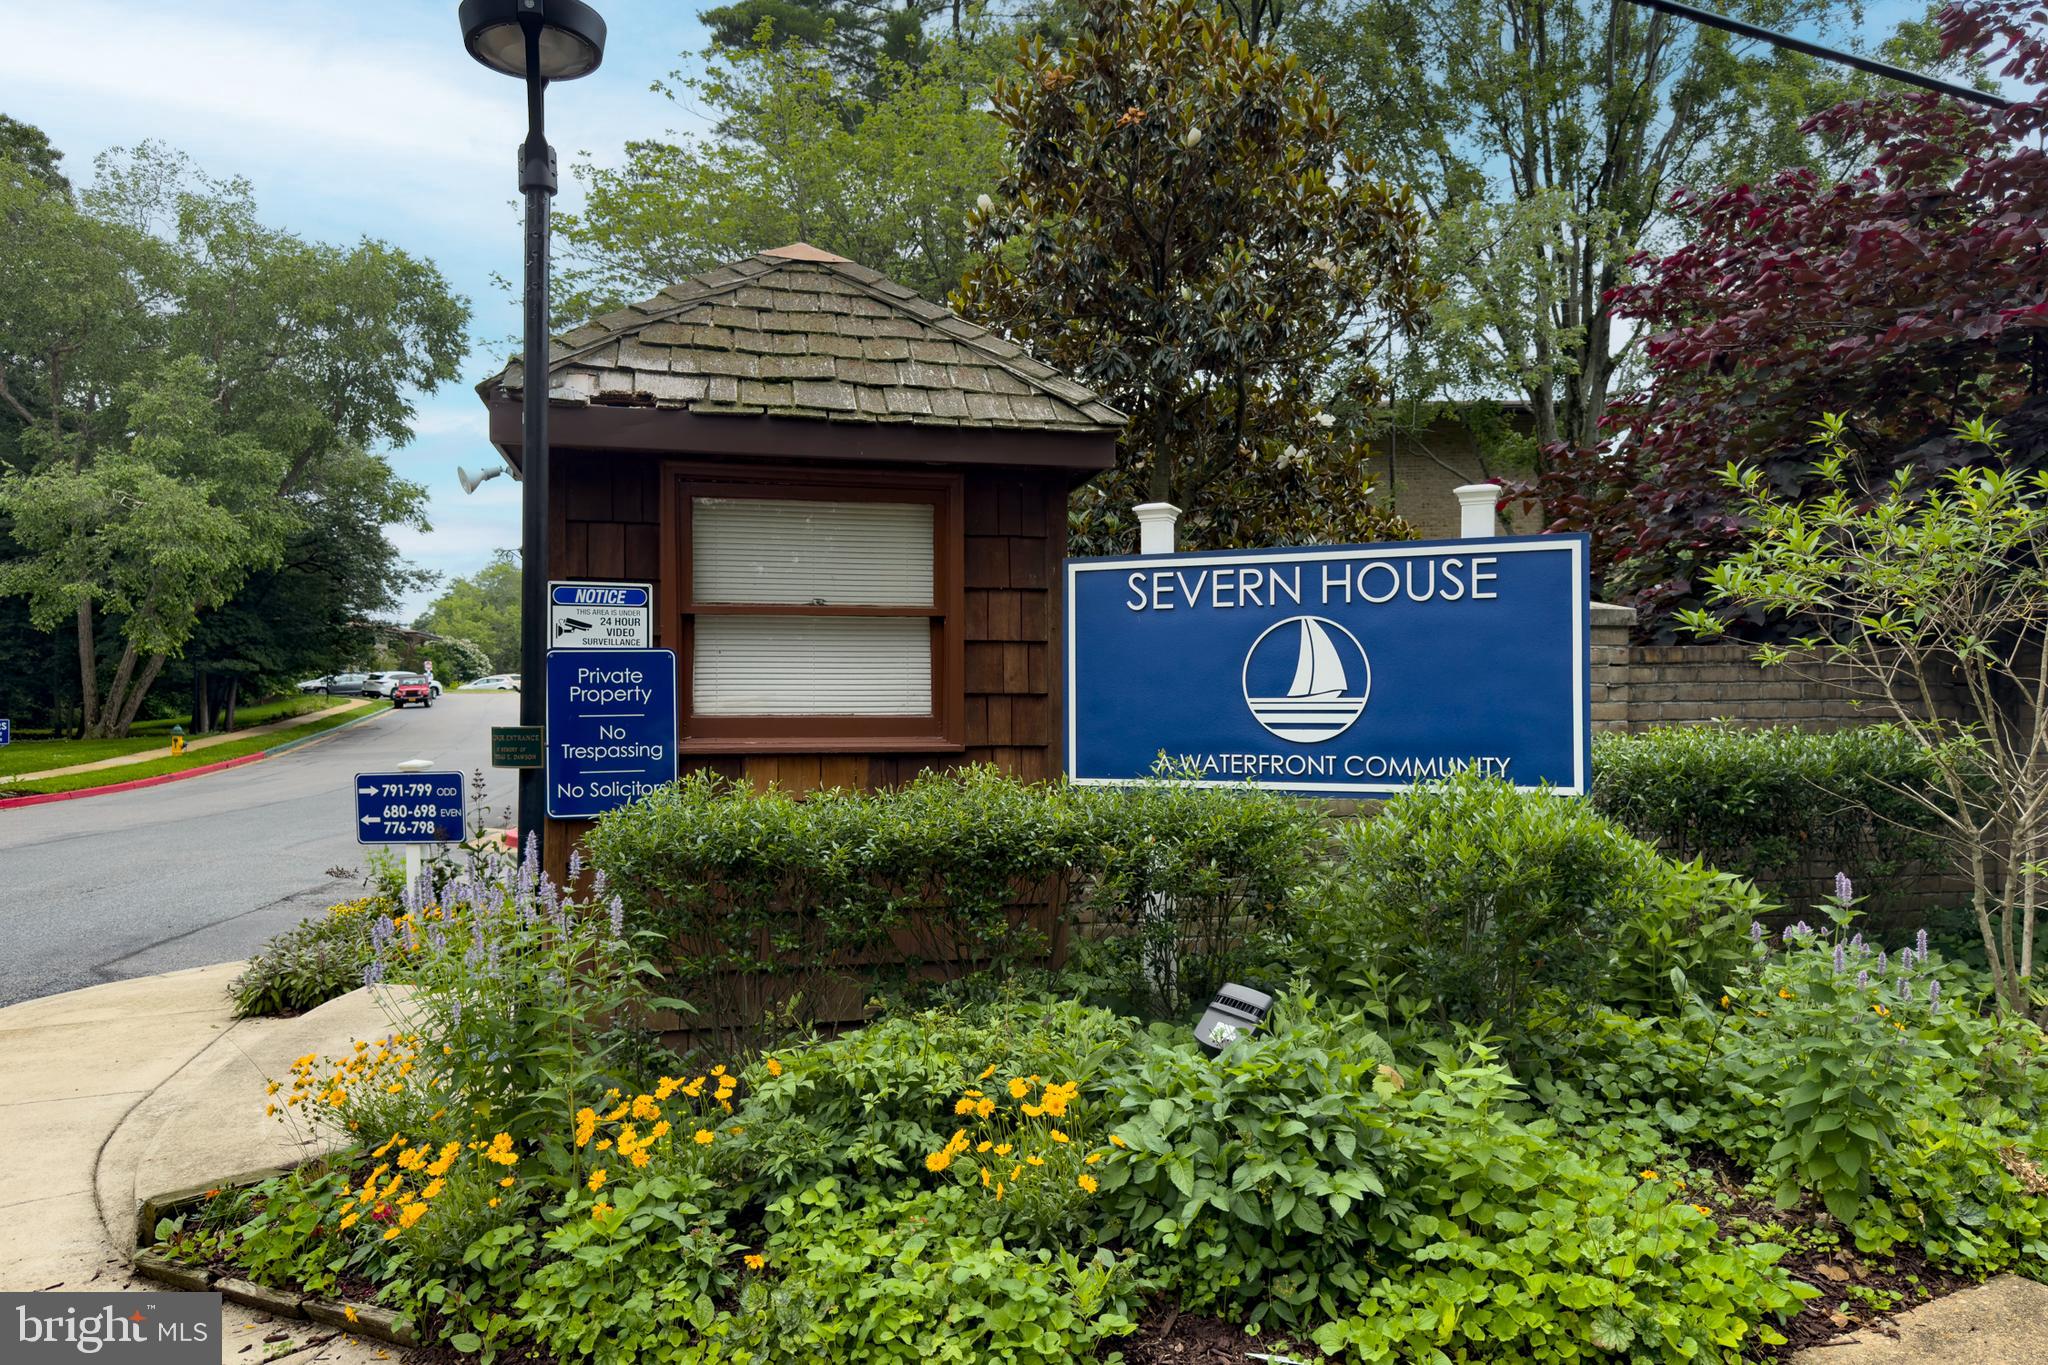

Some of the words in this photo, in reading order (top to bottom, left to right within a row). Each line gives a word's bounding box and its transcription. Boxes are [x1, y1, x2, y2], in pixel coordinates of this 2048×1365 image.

[1126, 566, 1301, 612] SEVERN
[1321, 557, 1498, 604] HOUSE
[575, 588, 627, 604] NOTICE
[576, 608, 591, 616] THIS
[592, 608, 609, 616] AREA
[619, 609, 641, 617] UNDER
[600, 617, 612, 626] 24
[614, 617, 641, 627] HOUR
[606, 627, 635, 638] VIDEO
[582, 637, 641, 647] SURVEILLANCE
[578, 667, 643, 685] Private
[569, 686, 653, 706] Property
[599, 725, 626, 741] No
[561, 742, 663, 762] Trespassing
[1157, 754, 1173, 773] A
[1180, 754, 1337, 776] WATERFRONT
[1343, 755, 1511, 778] COMMUNITY
[381, 783, 433, 798] 791-799
[436, 787, 457, 797] ODD
[557, 783, 585, 799] No
[383, 804, 437, 818] 680-698
[440, 808, 462, 818] EVEN
[383, 820, 436, 835] 776-798
